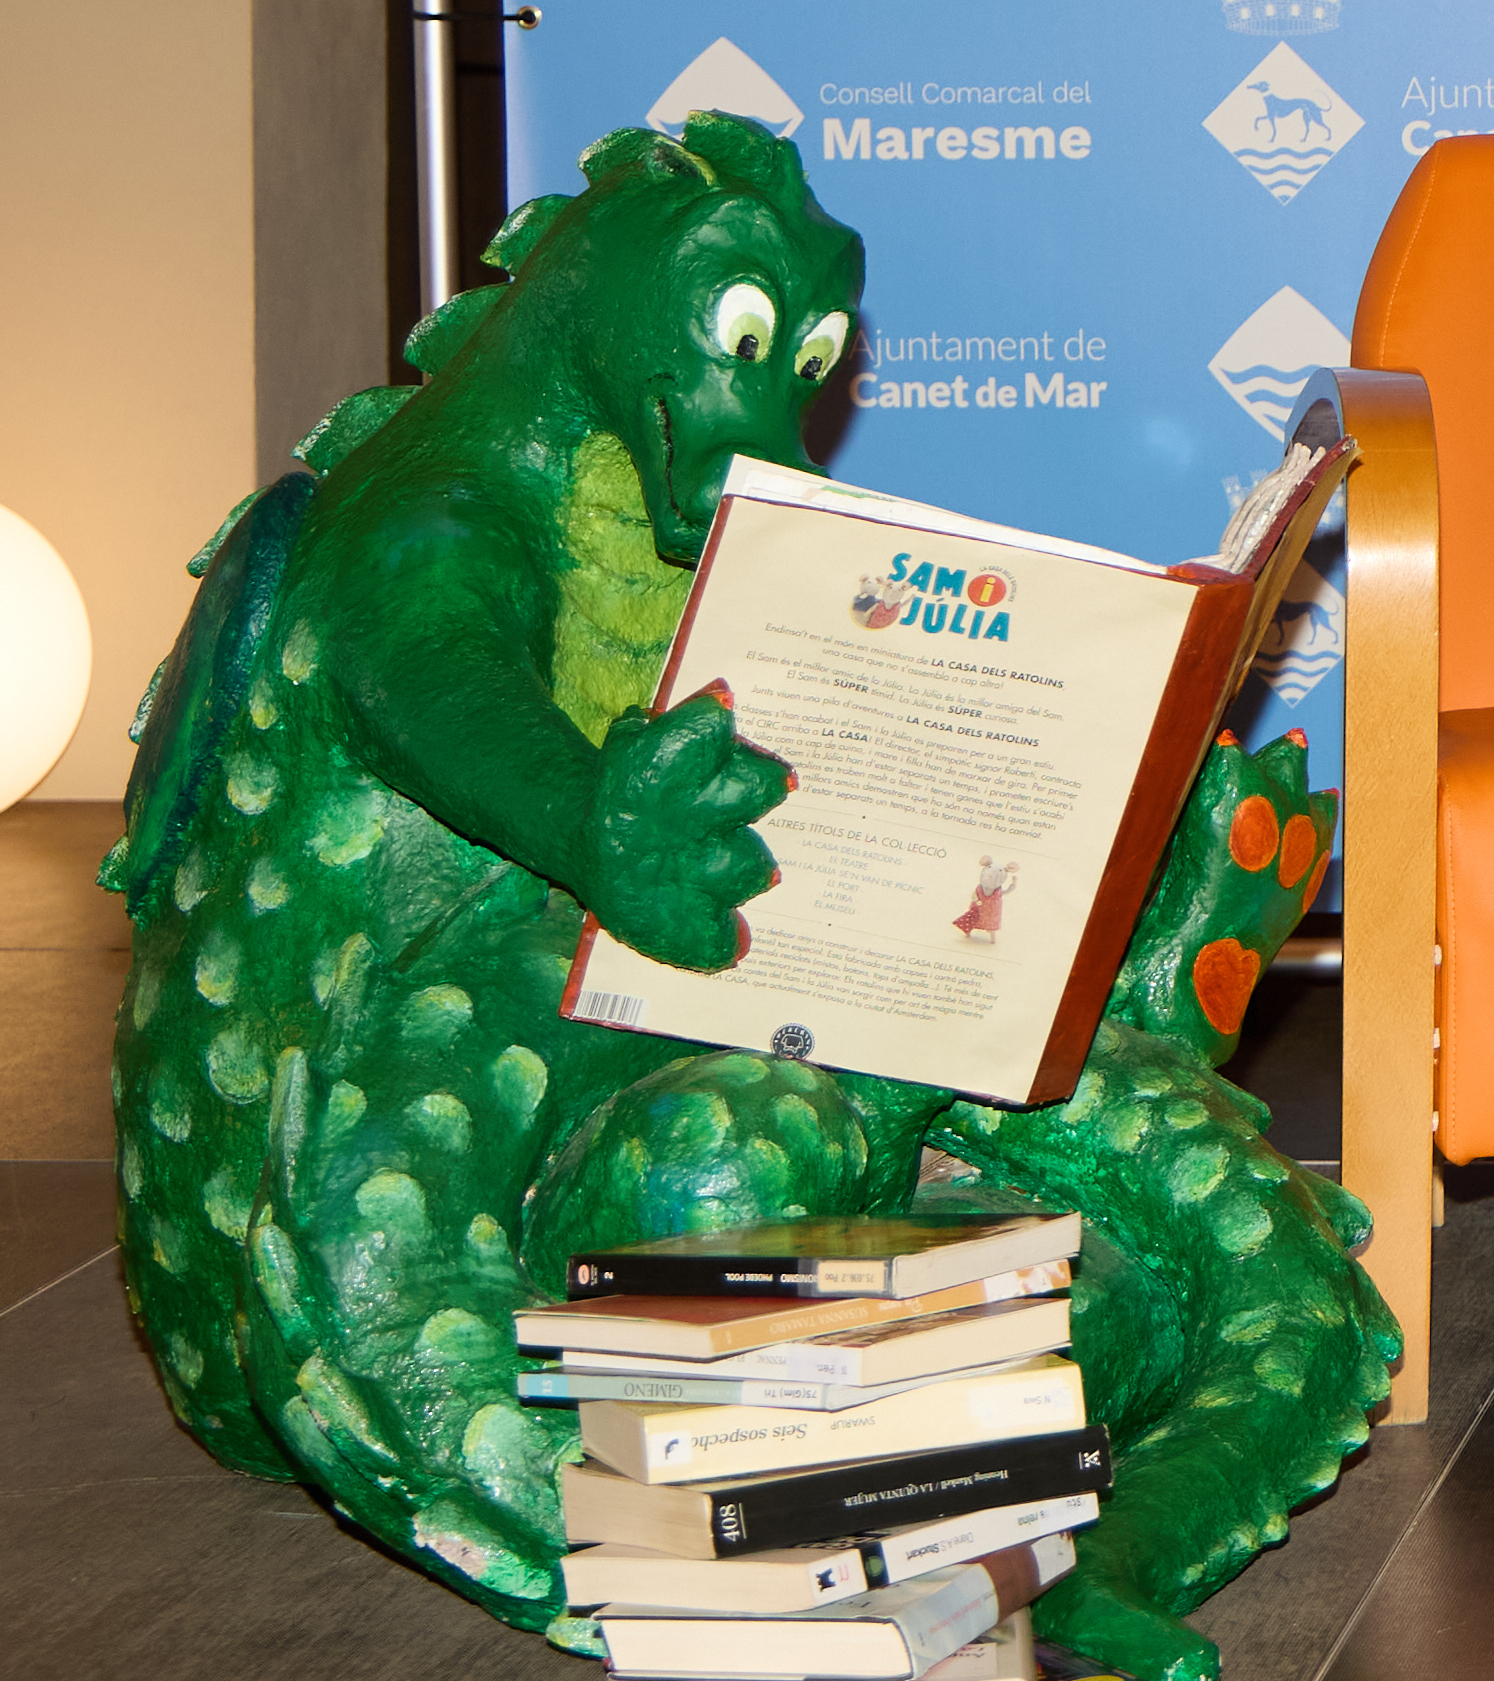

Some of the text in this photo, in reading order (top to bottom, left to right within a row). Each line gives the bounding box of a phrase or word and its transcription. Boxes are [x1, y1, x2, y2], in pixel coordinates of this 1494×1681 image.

[818, 81, 1091, 104] Consell Comarcal del
[821, 119, 1092, 160] Maresme
[847, 329, 1107, 366] Ajuntament de
[850, 373, 1106, 409] Canet de Mar
[887, 552, 967, 598] SAM
[899, 598, 1010, 642] JÚLIA
[765, 623, 807, 638] Endinsa't
[810, 634, 821, 642] en
[823, 635, 833, 643] el
[834, 638, 854, 649] món
[870, 646, 914, 663] miniatura
[917, 655, 929, 665] de
[931, 658, 944, 668] LA
[948, 661, 977, 673] CASA
[981, 666, 1007, 678] DELS
[822, 648, 840, 657] una
[843, 653, 864, 663] casa
[866, 657, 884, 669] que
[886, 662, 898, 671] no
[960, 677, 977, 688] cap
[776, 689, 801, 701] viuen
[803, 694, 820, 703] una
[822, 696, 840, 707] pila
[906, 715, 920, 725] LA
[923, 719, 953, 733] CASA
[957, 726, 983, 738] DELS
[767, 818, 805, 831] ALTRES
[809, 822, 844, 838] TÍTOLS
[847, 830, 862, 841] DE
[865, 834, 877, 844] LA
[769, 1306, 868, 1334] SUSANNA TAMARO
[624, 1382, 684, 1399] GIMENO
[772, 1423, 808, 1441] Seis
[830, 1416, 876, 1430] SWARUP
[844, 1469, 1008, 1507] Henning Mankell LA QUINTA MUJER
[721, 1503, 741, 1543] 408
